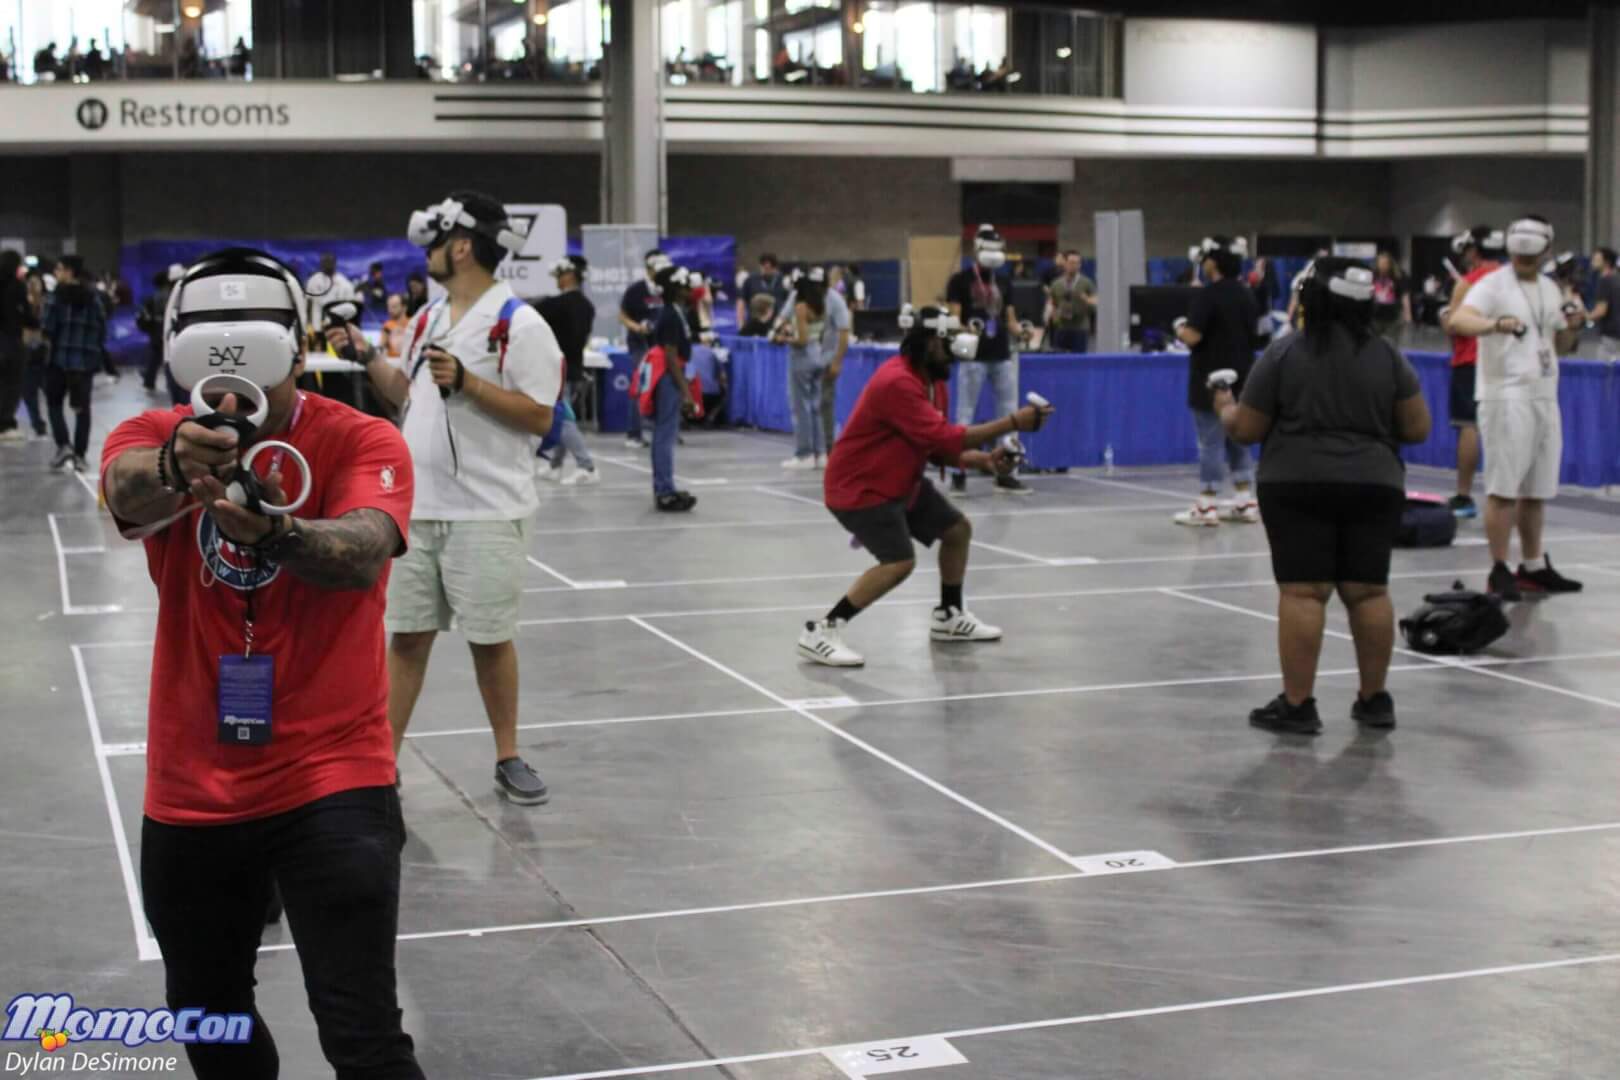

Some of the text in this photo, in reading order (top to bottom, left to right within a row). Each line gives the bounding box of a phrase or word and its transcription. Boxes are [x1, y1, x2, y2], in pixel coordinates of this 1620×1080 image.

[120, 99, 290, 127] Restrooms
[208, 344, 247, 367] BAZ
[1104, 858, 1145, 869] 20
[866, 1045, 920, 1062] 25
